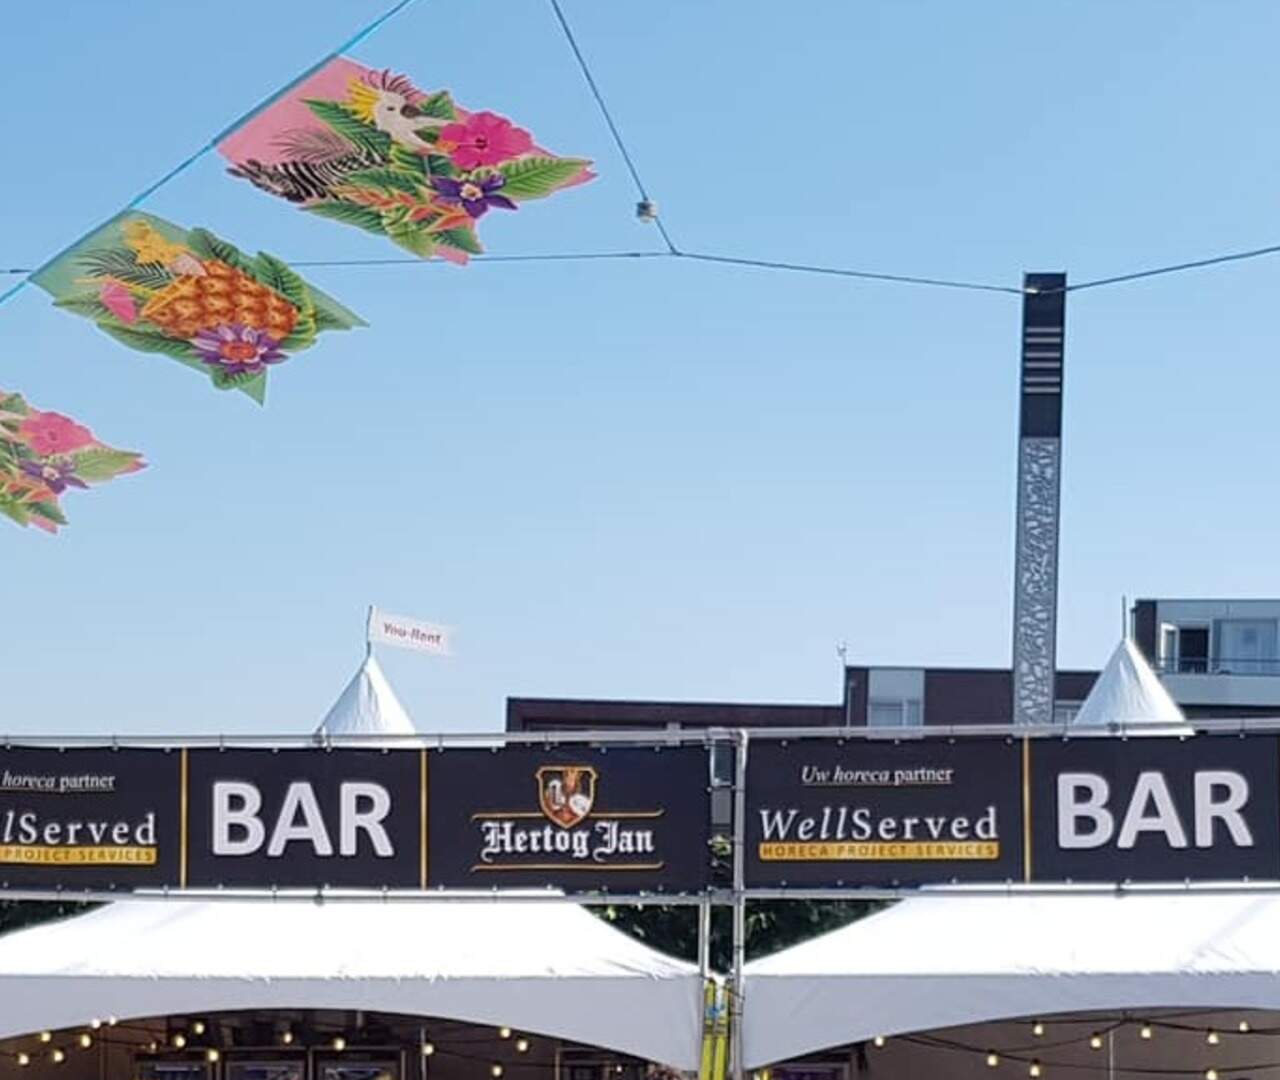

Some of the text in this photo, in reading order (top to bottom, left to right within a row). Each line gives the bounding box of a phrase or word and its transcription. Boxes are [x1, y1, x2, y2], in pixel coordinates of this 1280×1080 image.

[3, 771, 56, 788] horeca
[60, 774, 116, 793] partner
[801, 765, 954, 786] Uw horeca partner
[212, 781, 395, 857] BAR
[760, 806, 999, 840] WellServed
[1056, 772, 1253, 849] BAR
[5, 849, 71, 861] PROJECT
[80, 850, 153, 862] SERVICES
[480, 821, 654, 863] Hertog Jan
[762, 844, 996, 857] HORECA PROJECT SERVICES
